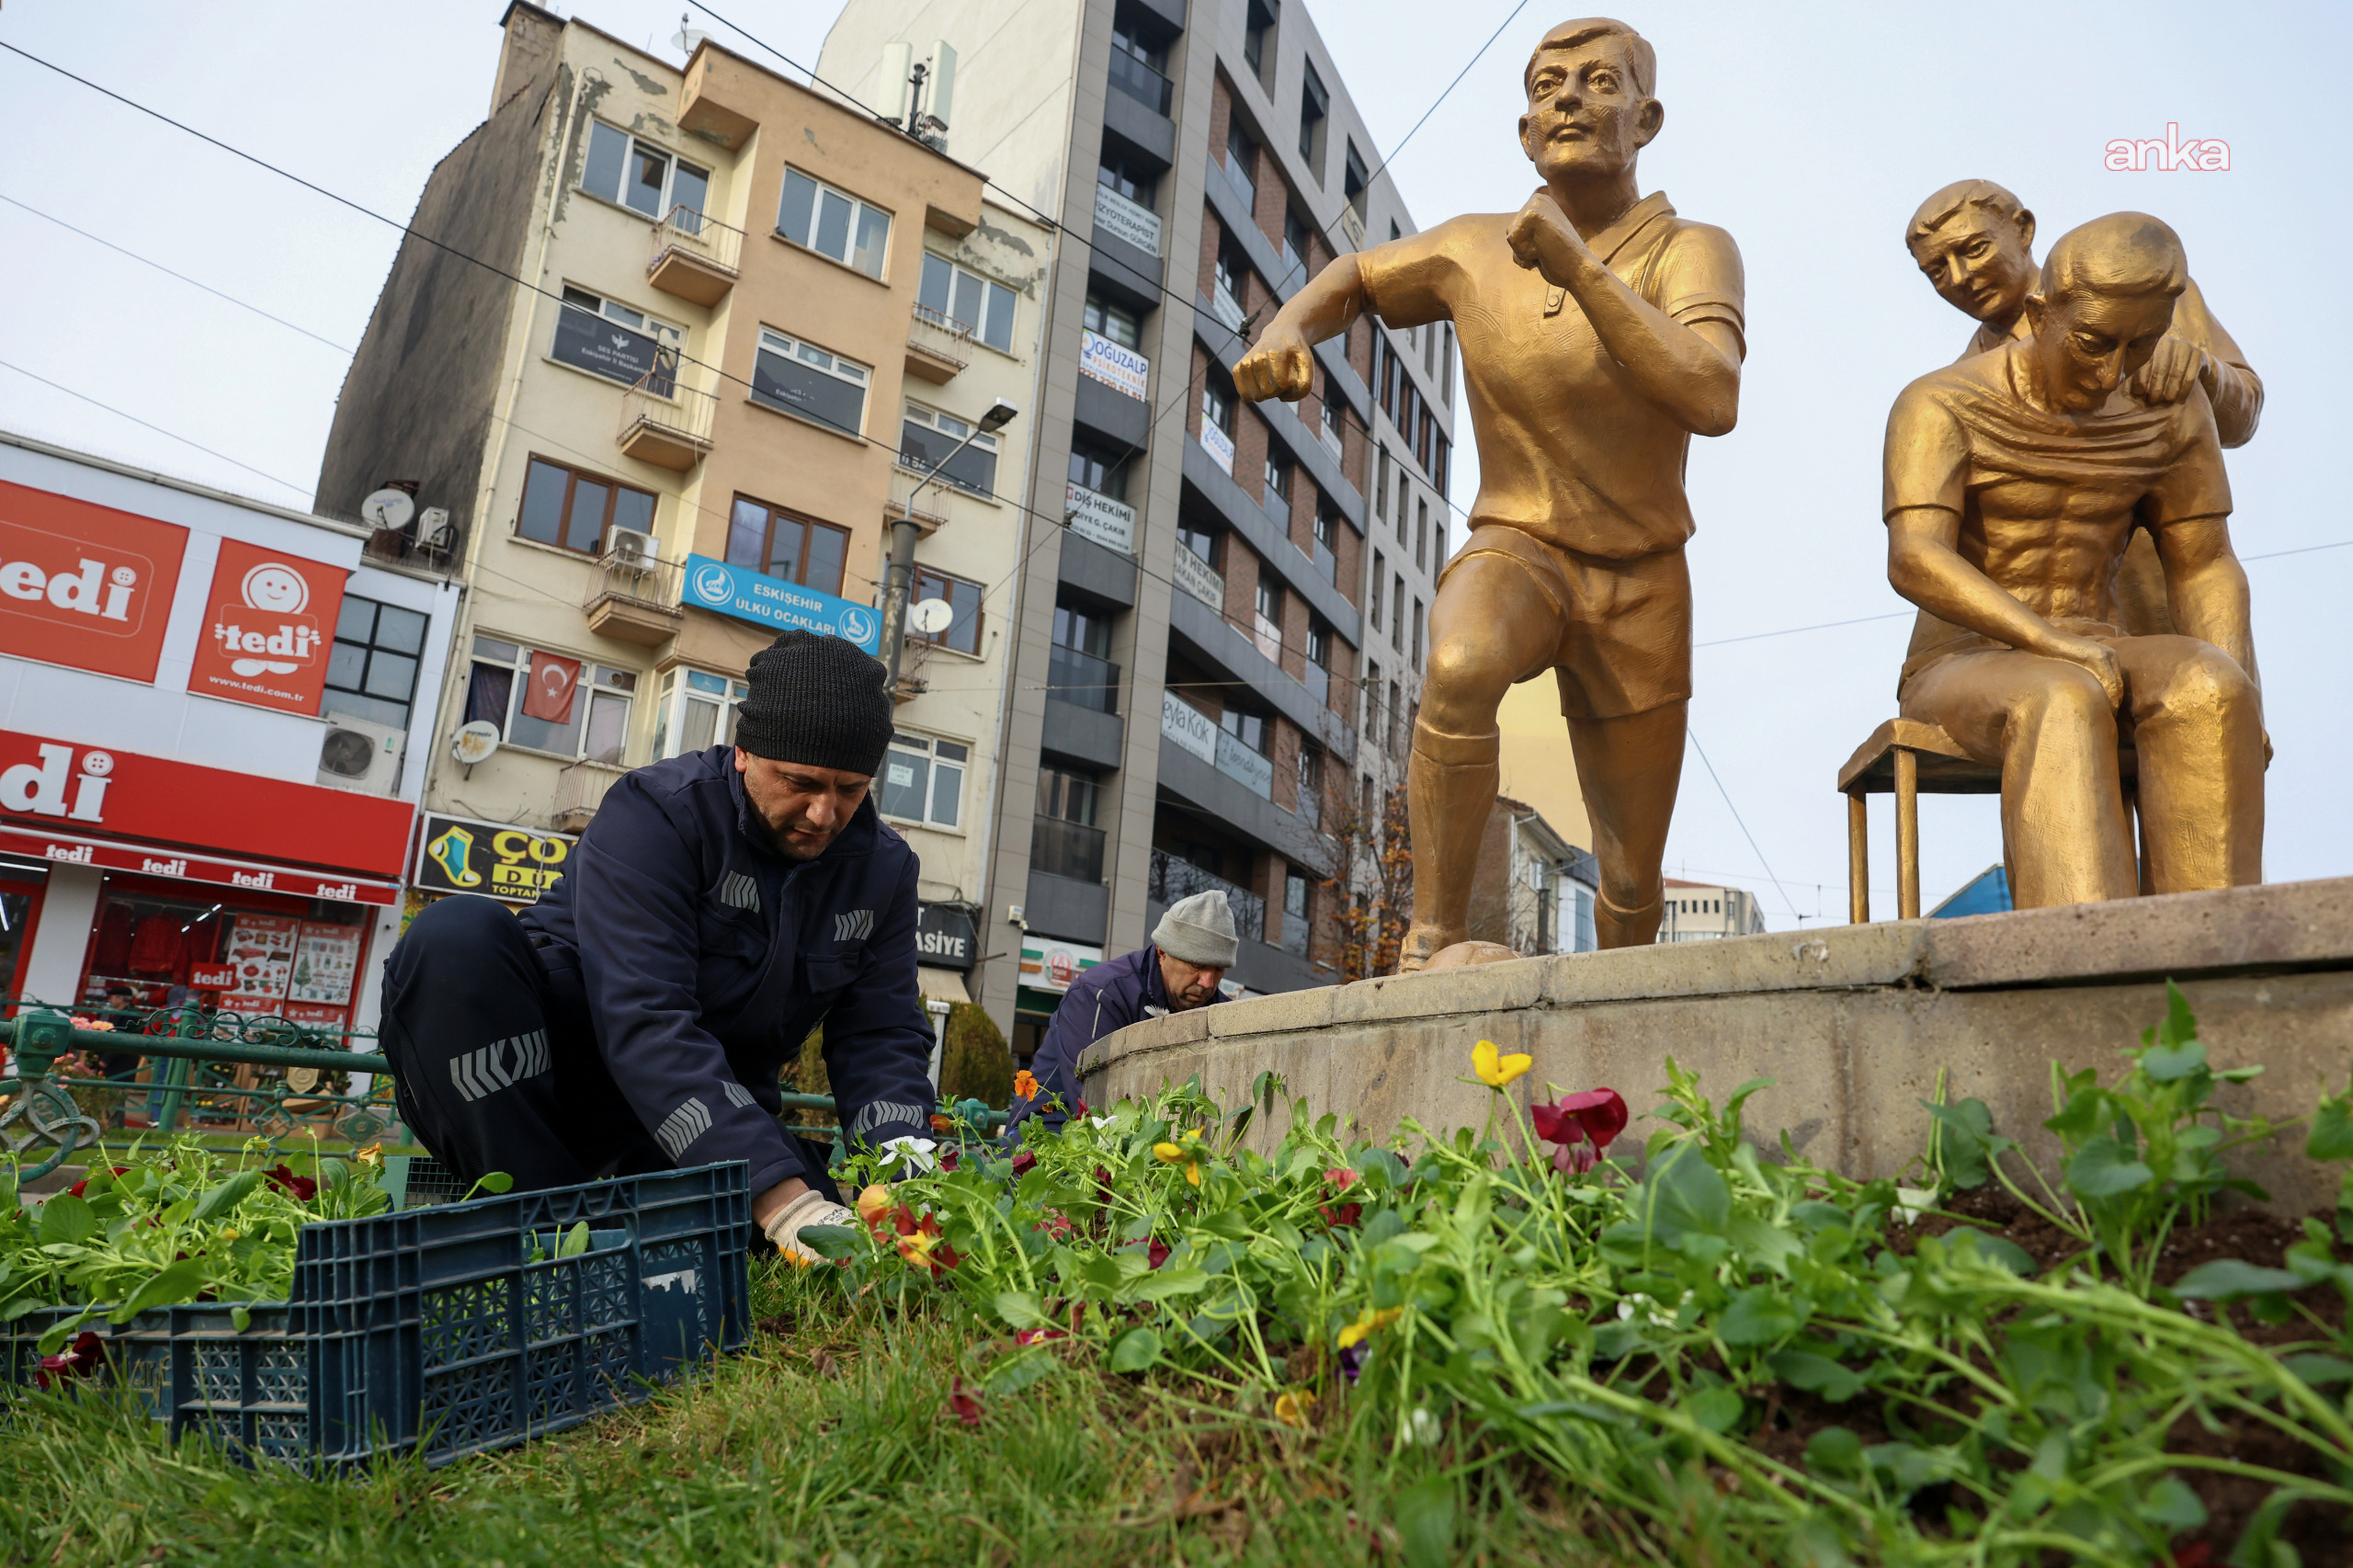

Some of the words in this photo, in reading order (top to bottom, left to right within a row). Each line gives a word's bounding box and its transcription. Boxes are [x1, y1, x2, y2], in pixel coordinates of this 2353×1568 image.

[1095, 340, 1147, 376] OĞUZALP
[1074, 490, 1092, 509] DİŞ
[1094, 498, 1131, 523] HEKİMİ
[1103, 521, 1127, 538] ÇAKIR
[754, 582, 824, 614] ESKİŞEHİR
[735, 595, 771, 618] ÜLKÜ
[774, 608, 836, 636] OCAKLARI
[224, 625, 311, 658] tedi
[208, 675, 305, 702] www.tedi.com.tr
[1187, 710, 1210, 745] Kök
[45, 843, 95, 864] tedi
[142, 858, 188, 877] tedi
[232, 870, 275, 890] tedi
[315, 883, 358, 902] tedi
[192, 970, 233, 986] tedi
